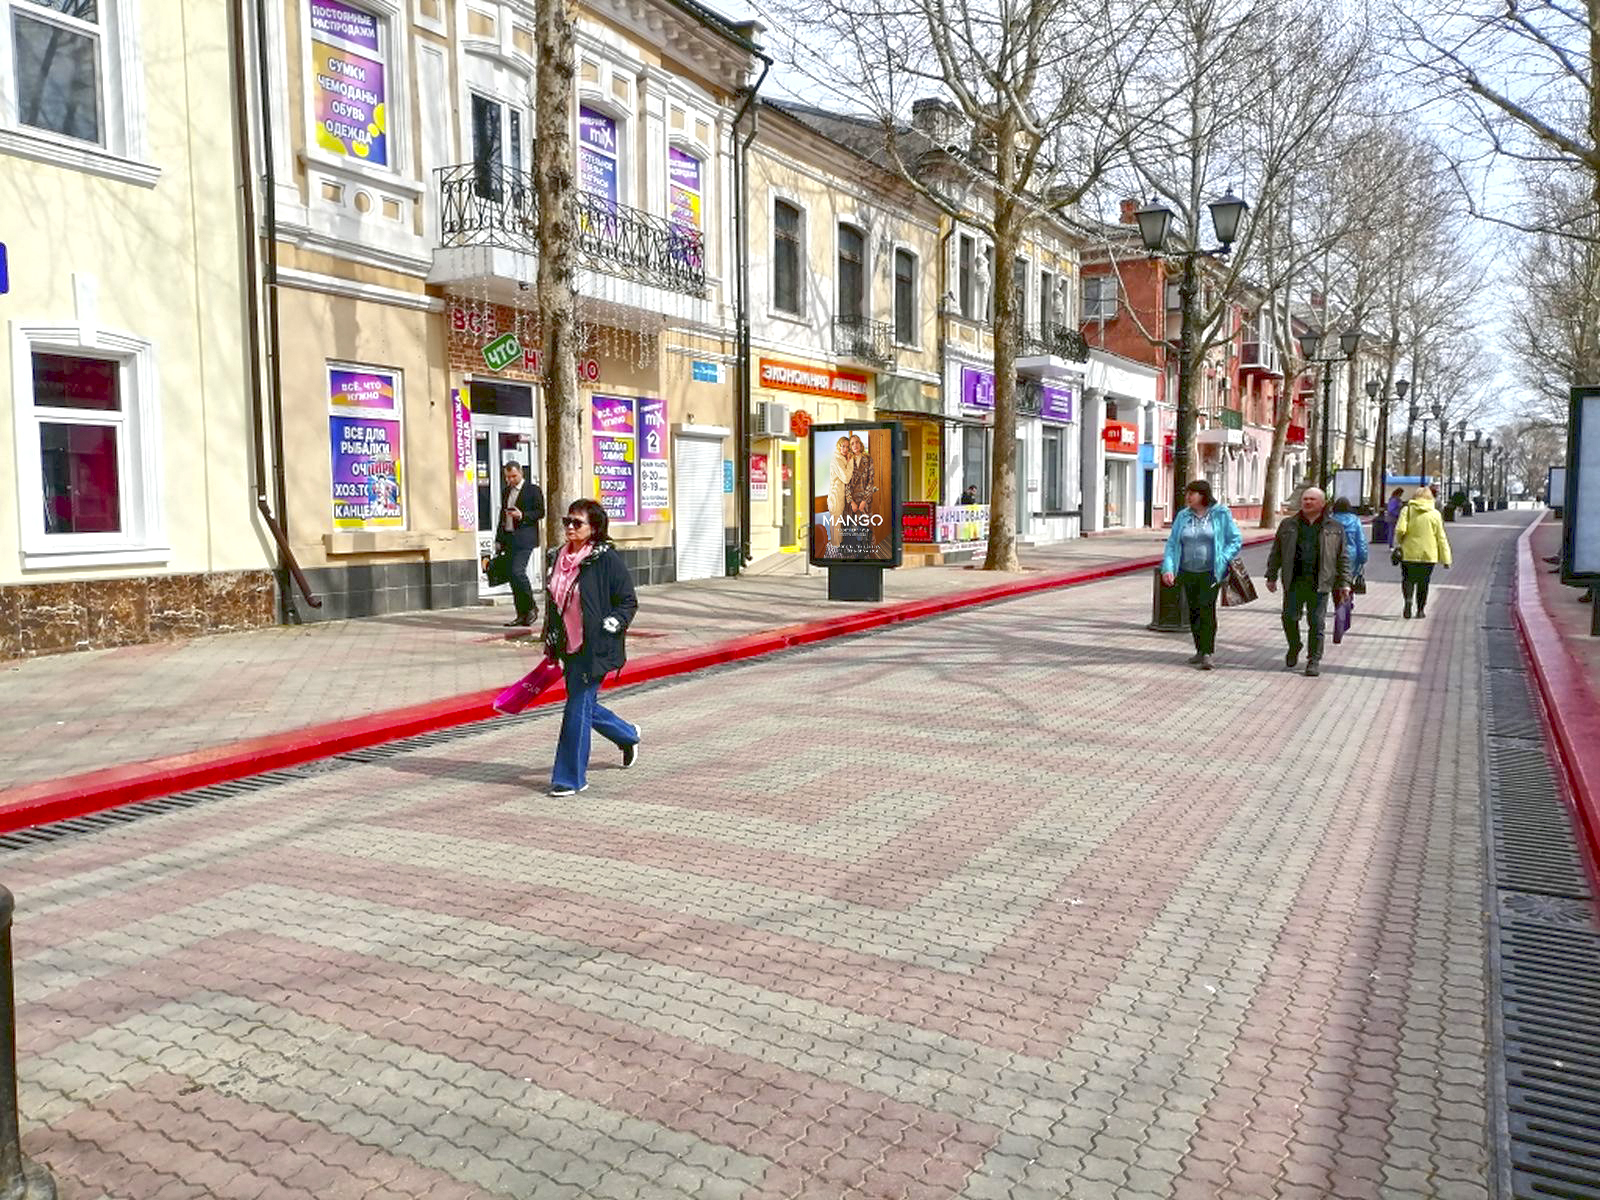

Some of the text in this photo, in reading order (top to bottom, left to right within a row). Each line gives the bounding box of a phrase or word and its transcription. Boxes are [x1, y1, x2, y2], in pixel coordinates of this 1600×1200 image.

[312, 17, 376, 39] РАСПРОДАЖИ
[328, 58, 366, 82] СУМКИ
[317, 73, 378, 105] ЧЕМОДАНЫ
[332, 100, 366, 122] ОБУВЬ
[325, 119, 373, 145] ОДЕЖДА
[488, 339, 517, 365] ЧТО
[363, 381, 382, 390] ЧТО
[761, 364, 830, 390] ЭКОНОМНАЯ
[344, 426, 386, 443] ВСЕ ДЛЯ
[454, 395, 465, 471] РАСПРОДАЖА
[650, 432, 657, 448] 2
[340, 442, 391, 455] РЫБАЛКИ
[594, 465, 632, 475] КОСМЕТИКА
[600, 480, 627, 491] ПОСУДА
[822, 514, 884, 527] MANGO
